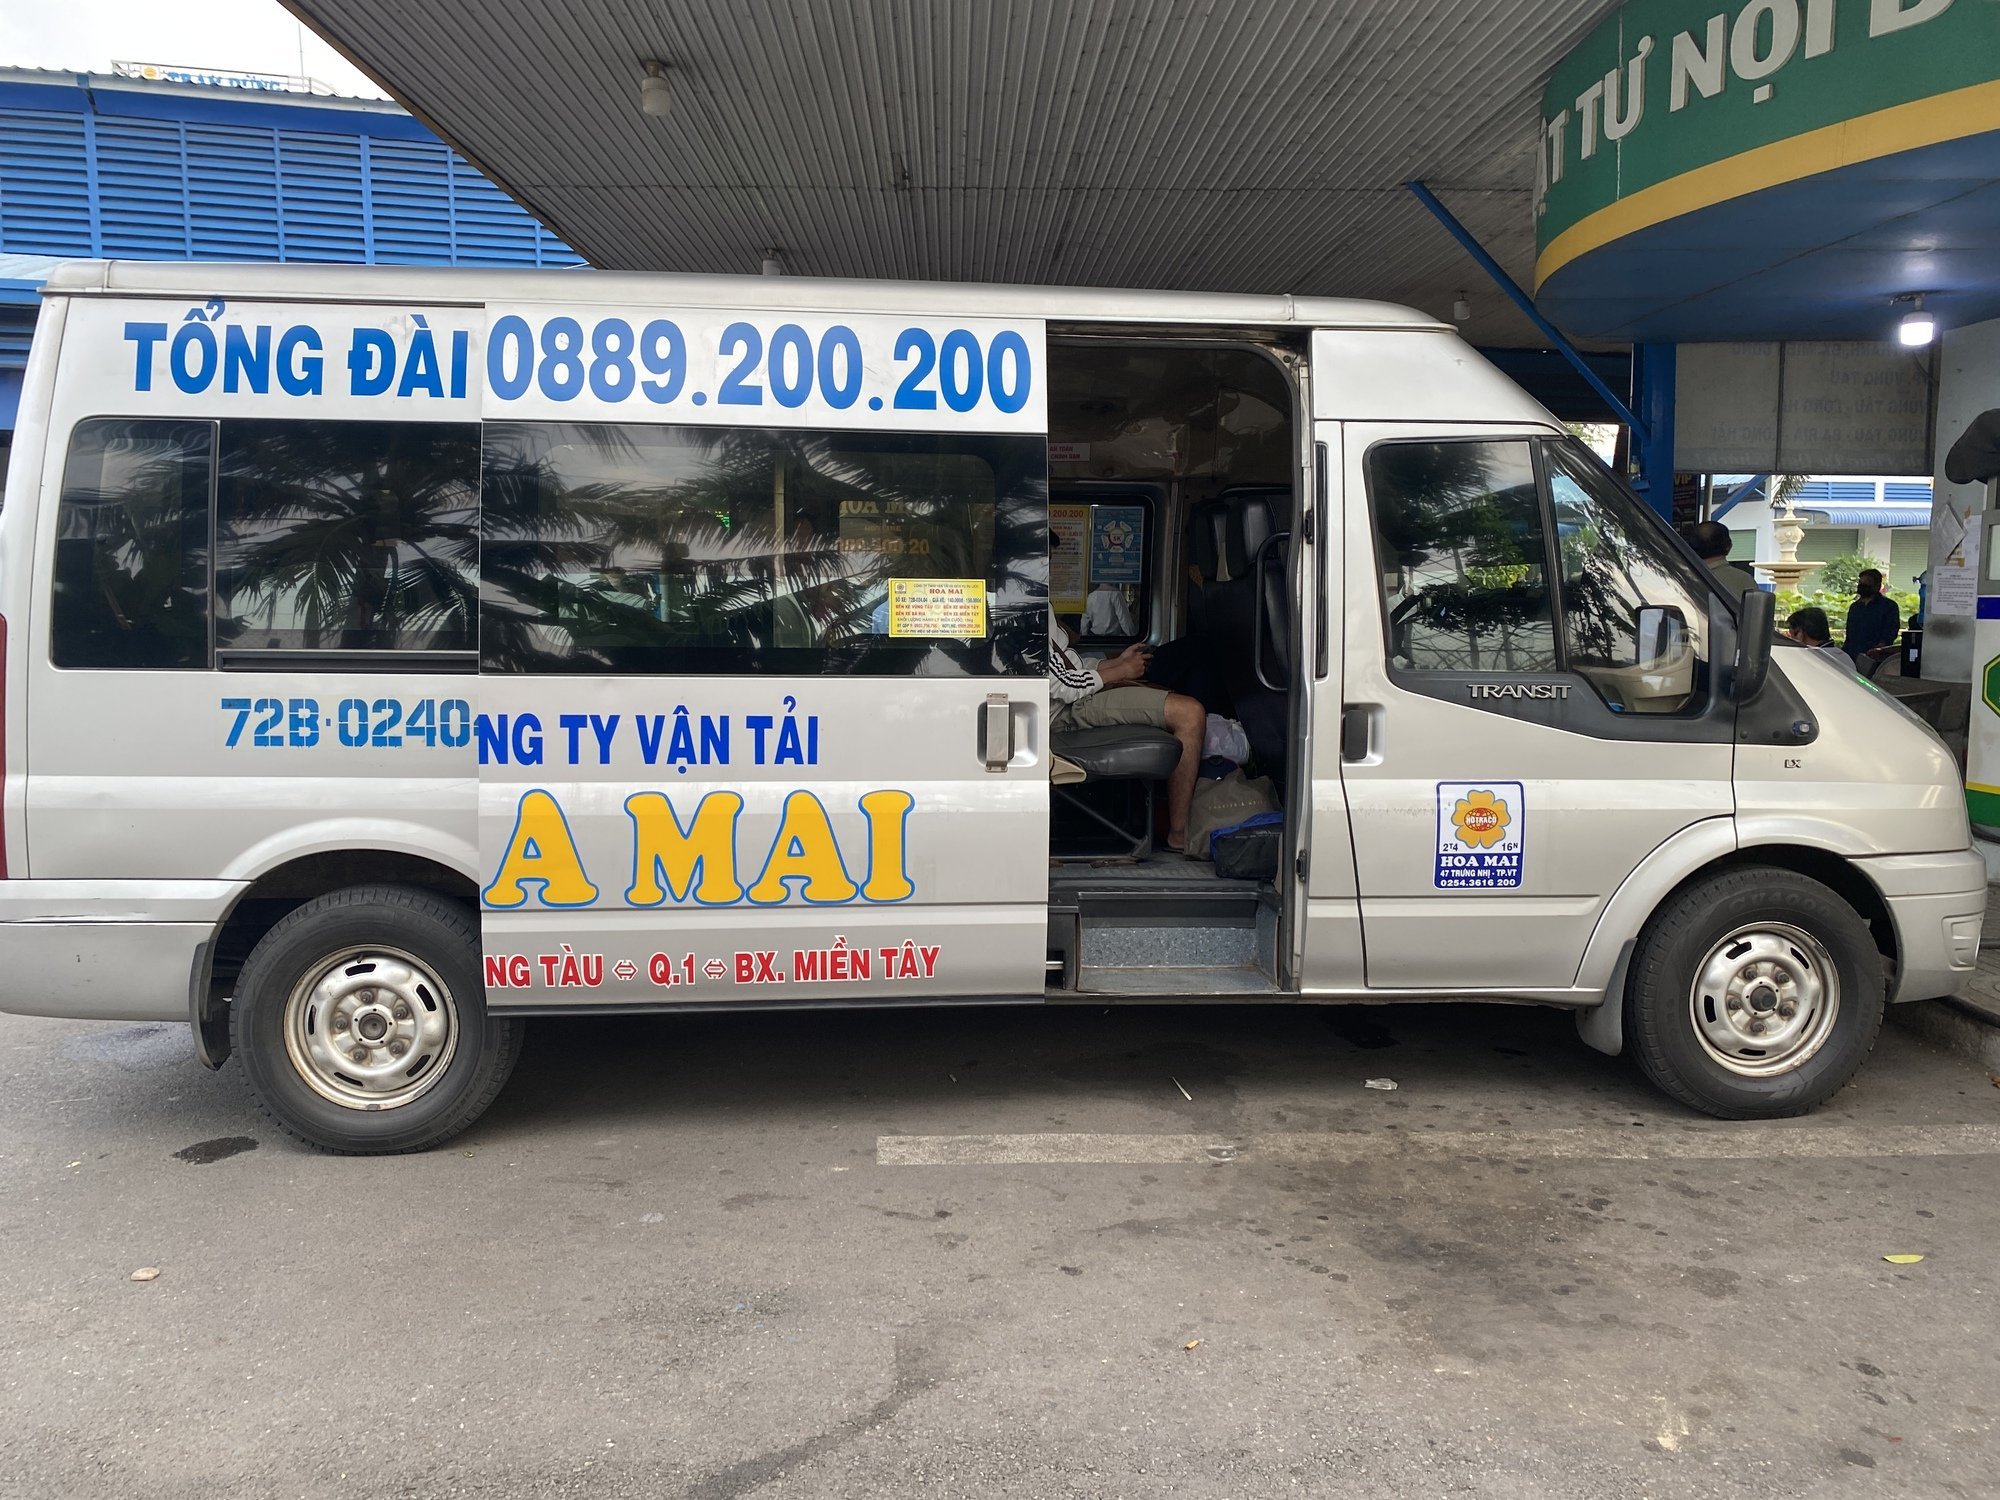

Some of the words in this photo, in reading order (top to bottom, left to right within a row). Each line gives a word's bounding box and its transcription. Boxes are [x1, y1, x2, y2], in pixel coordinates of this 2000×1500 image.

[1576, 35, 1654, 160] TƯ
[125, 295, 323, 395] TỔNG
[348, 314, 468, 398] ĐÀI
[486, 314, 1032, 415] 0889.200.200
[1467, 684, 1572, 699] TRANSIT
[478, 713, 543, 765] NG
[560, 714, 620, 765] TY
[635, 705, 730, 774] VẬN
[746, 695, 818, 765] TẢI
[1784, 758, 1801, 769] LX
[1465, 816, 1497, 824] HOTRACO
[481, 788, 600, 908] A
[624, 789, 915, 908] MAI
[1440, 855, 1479, 867] HOA
[1483, 855, 1518, 867] MAI
[1440, 869, 1449, 877] 47
[1477, 869, 1491, 878] NHỊ
[1496, 869, 1517, 877] TP.VT
[1440, 879, 1494, 887] 0254.3616
[1496, 879, 1516, 887] 200
[484, 954, 532, 989] NG
[538, 943, 604, 988] TÀU
[648, 951, 696, 989] Q.1
[734, 950, 785, 985] BX.
[794, 935, 872, 984] MIỀN
[879, 938, 942, 980] TÂY
